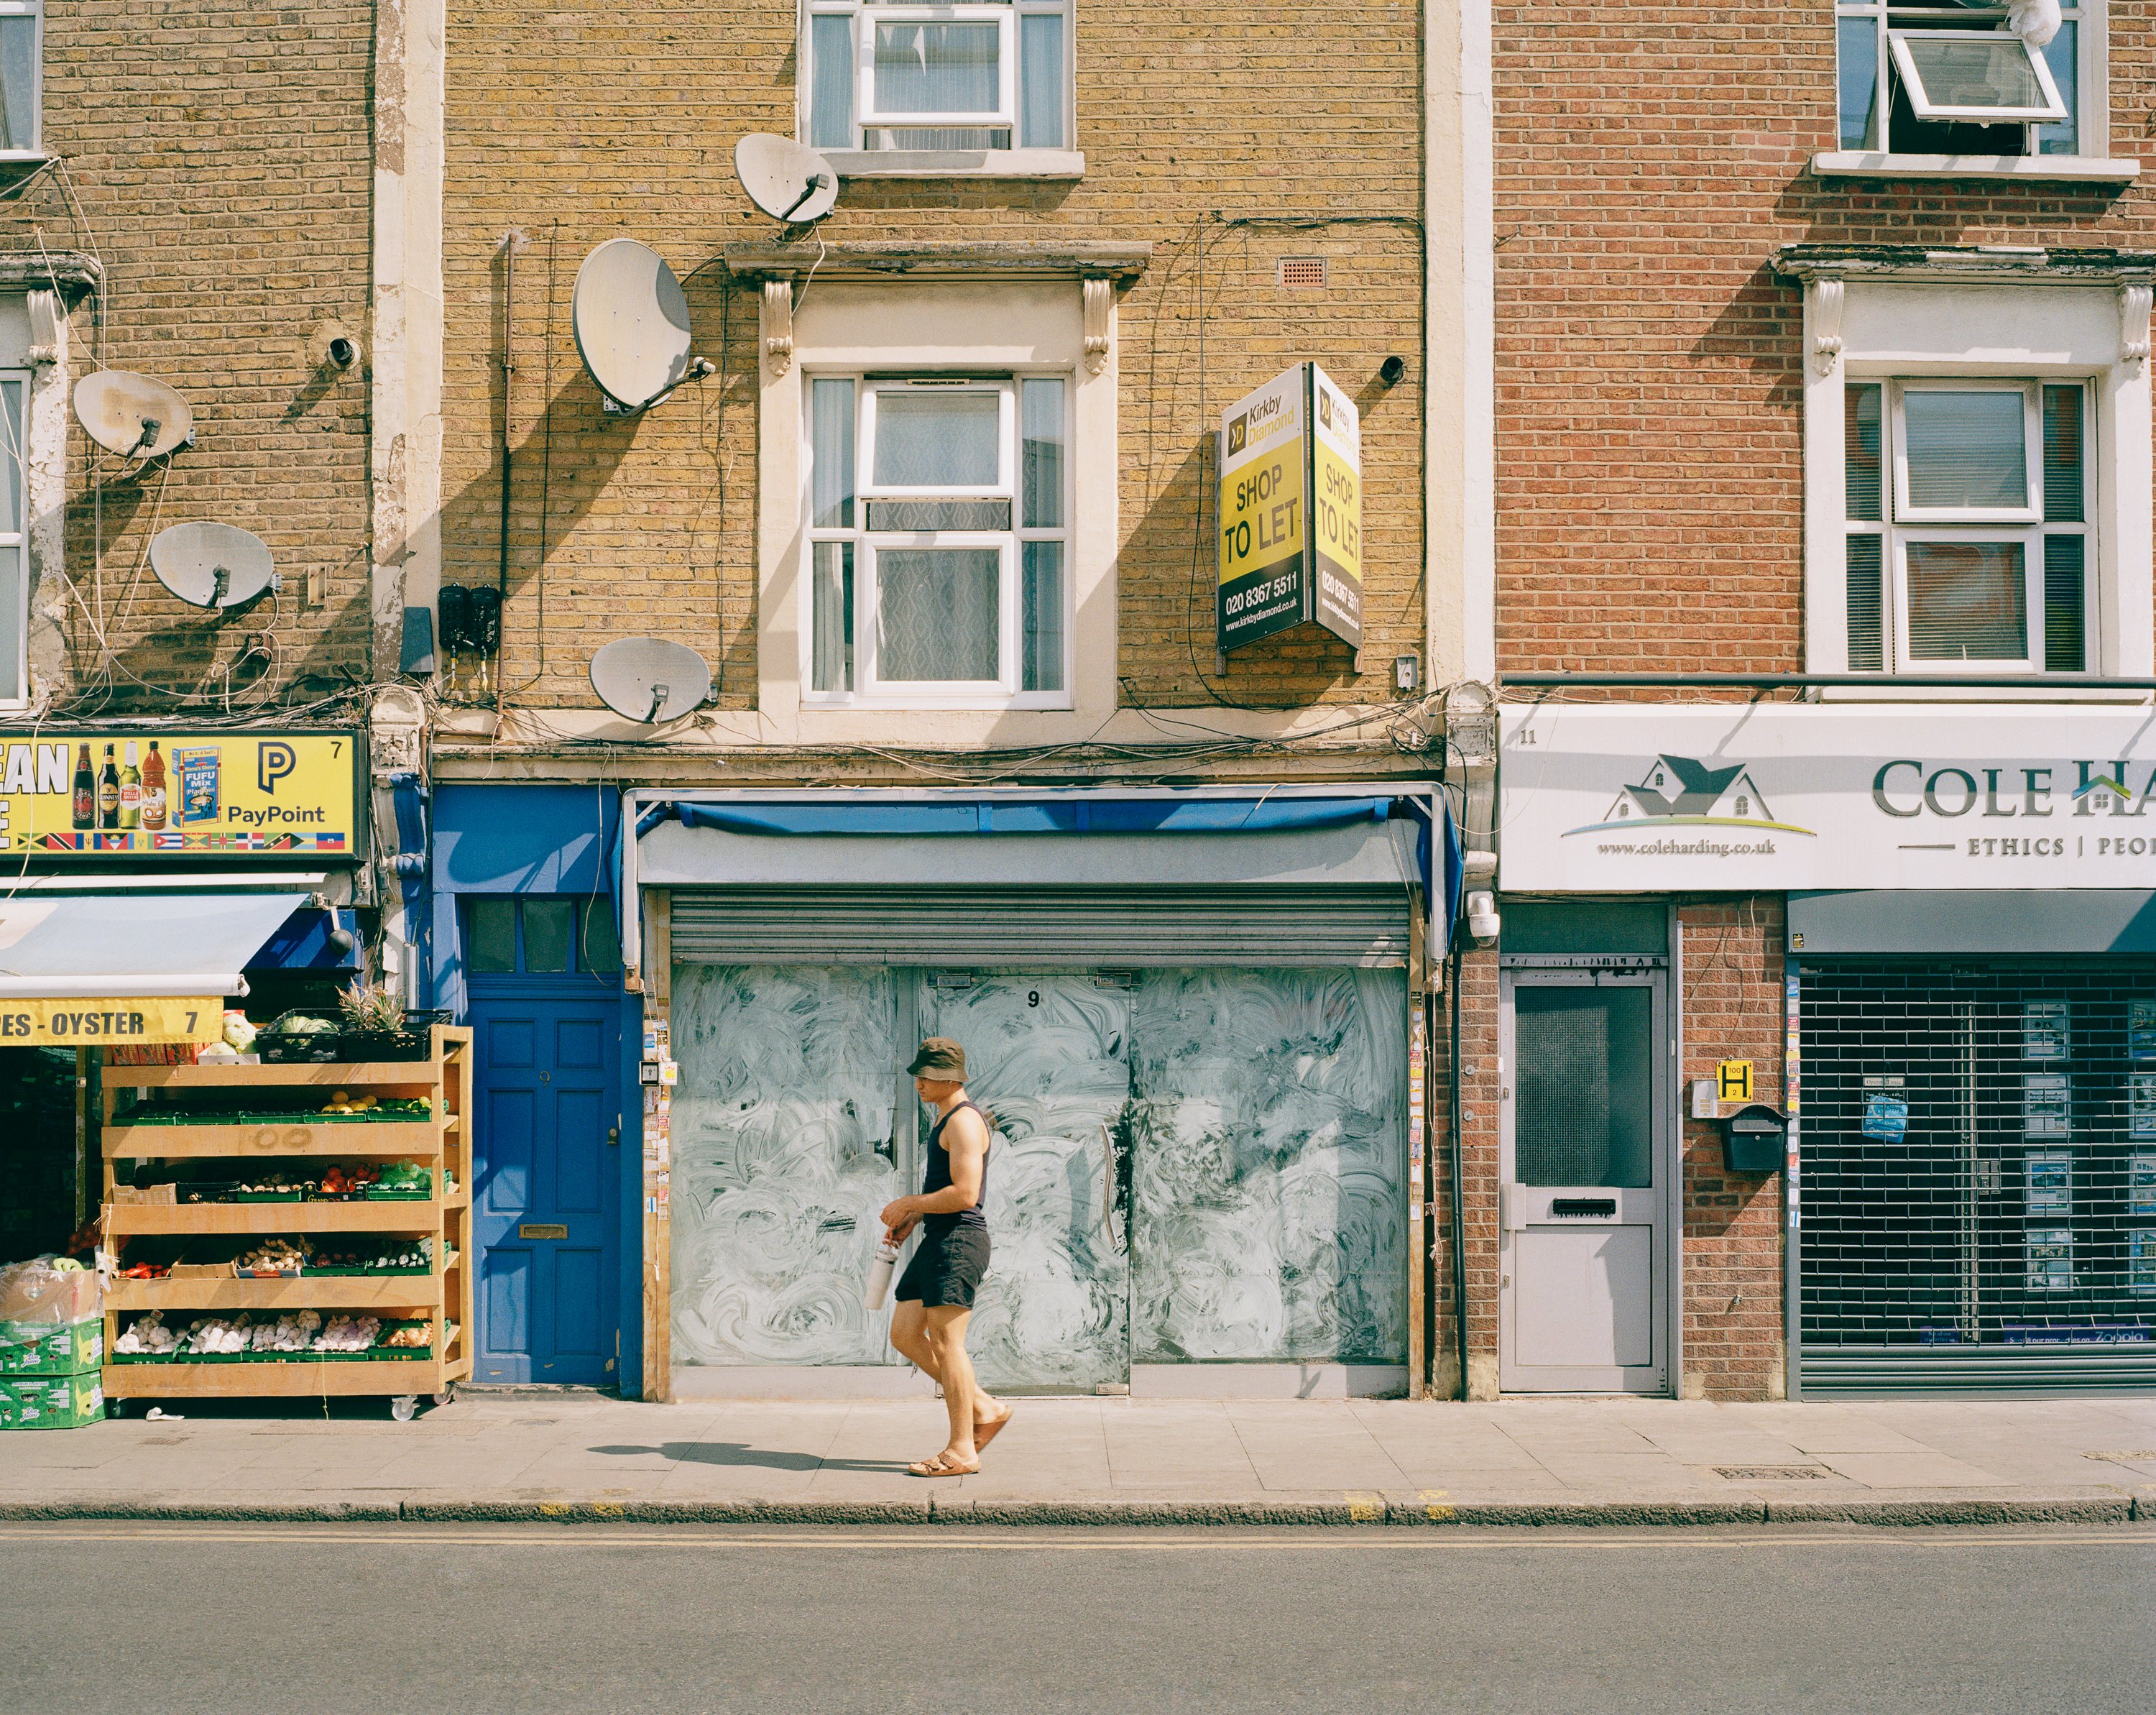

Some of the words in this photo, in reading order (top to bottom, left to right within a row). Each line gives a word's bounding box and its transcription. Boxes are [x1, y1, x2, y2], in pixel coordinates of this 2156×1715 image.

[1248, 405, 1294, 447] Diamond
[1250, 395, 1281, 425] Kirkby
[1332, 396, 1350, 433] Kirkby
[1236, 464, 1283, 512] SHOP
[1326, 463, 1353, 509] SHOP
[1225, 520, 1250, 564] TO
[1258, 497, 1297, 551] LET
[1319, 496, 1337, 543] TO
[1341, 513, 1358, 562] LET
[1225, 592, 1245, 615] 020
[1245, 581, 1272, 608] 8367
[1273, 571, 1296, 598] 5511
[1322, 570, 1335, 594] 020
[1335, 579, 1348, 604] 8367
[1348, 589, 1359, 615] 5511
[1225, 596, 1297, 632] www.kirkbydiamond.co.uk
[331, 741, 343, 759] 7
[1519, 729, 1537, 745] 11
[0, 744, 69, 795] AN
[186, 771, 216, 781] FUFU
[1873, 759, 2054, 817] COLE
[228, 806, 326, 827] PayPoint
[1598, 839, 1777, 858] www.coleharding.co.uk
[1968, 837, 2064, 856] ETHICS
[1028, 990, 1040, 1008] 9
[0, 1014, 31, 1036] ES
[51, 1011, 144, 1036] OYSTER
[185, 1011, 198, 1034] 7
[540, 1070, 550, 1088] 9
[1721, 1065, 1747, 1098] H
